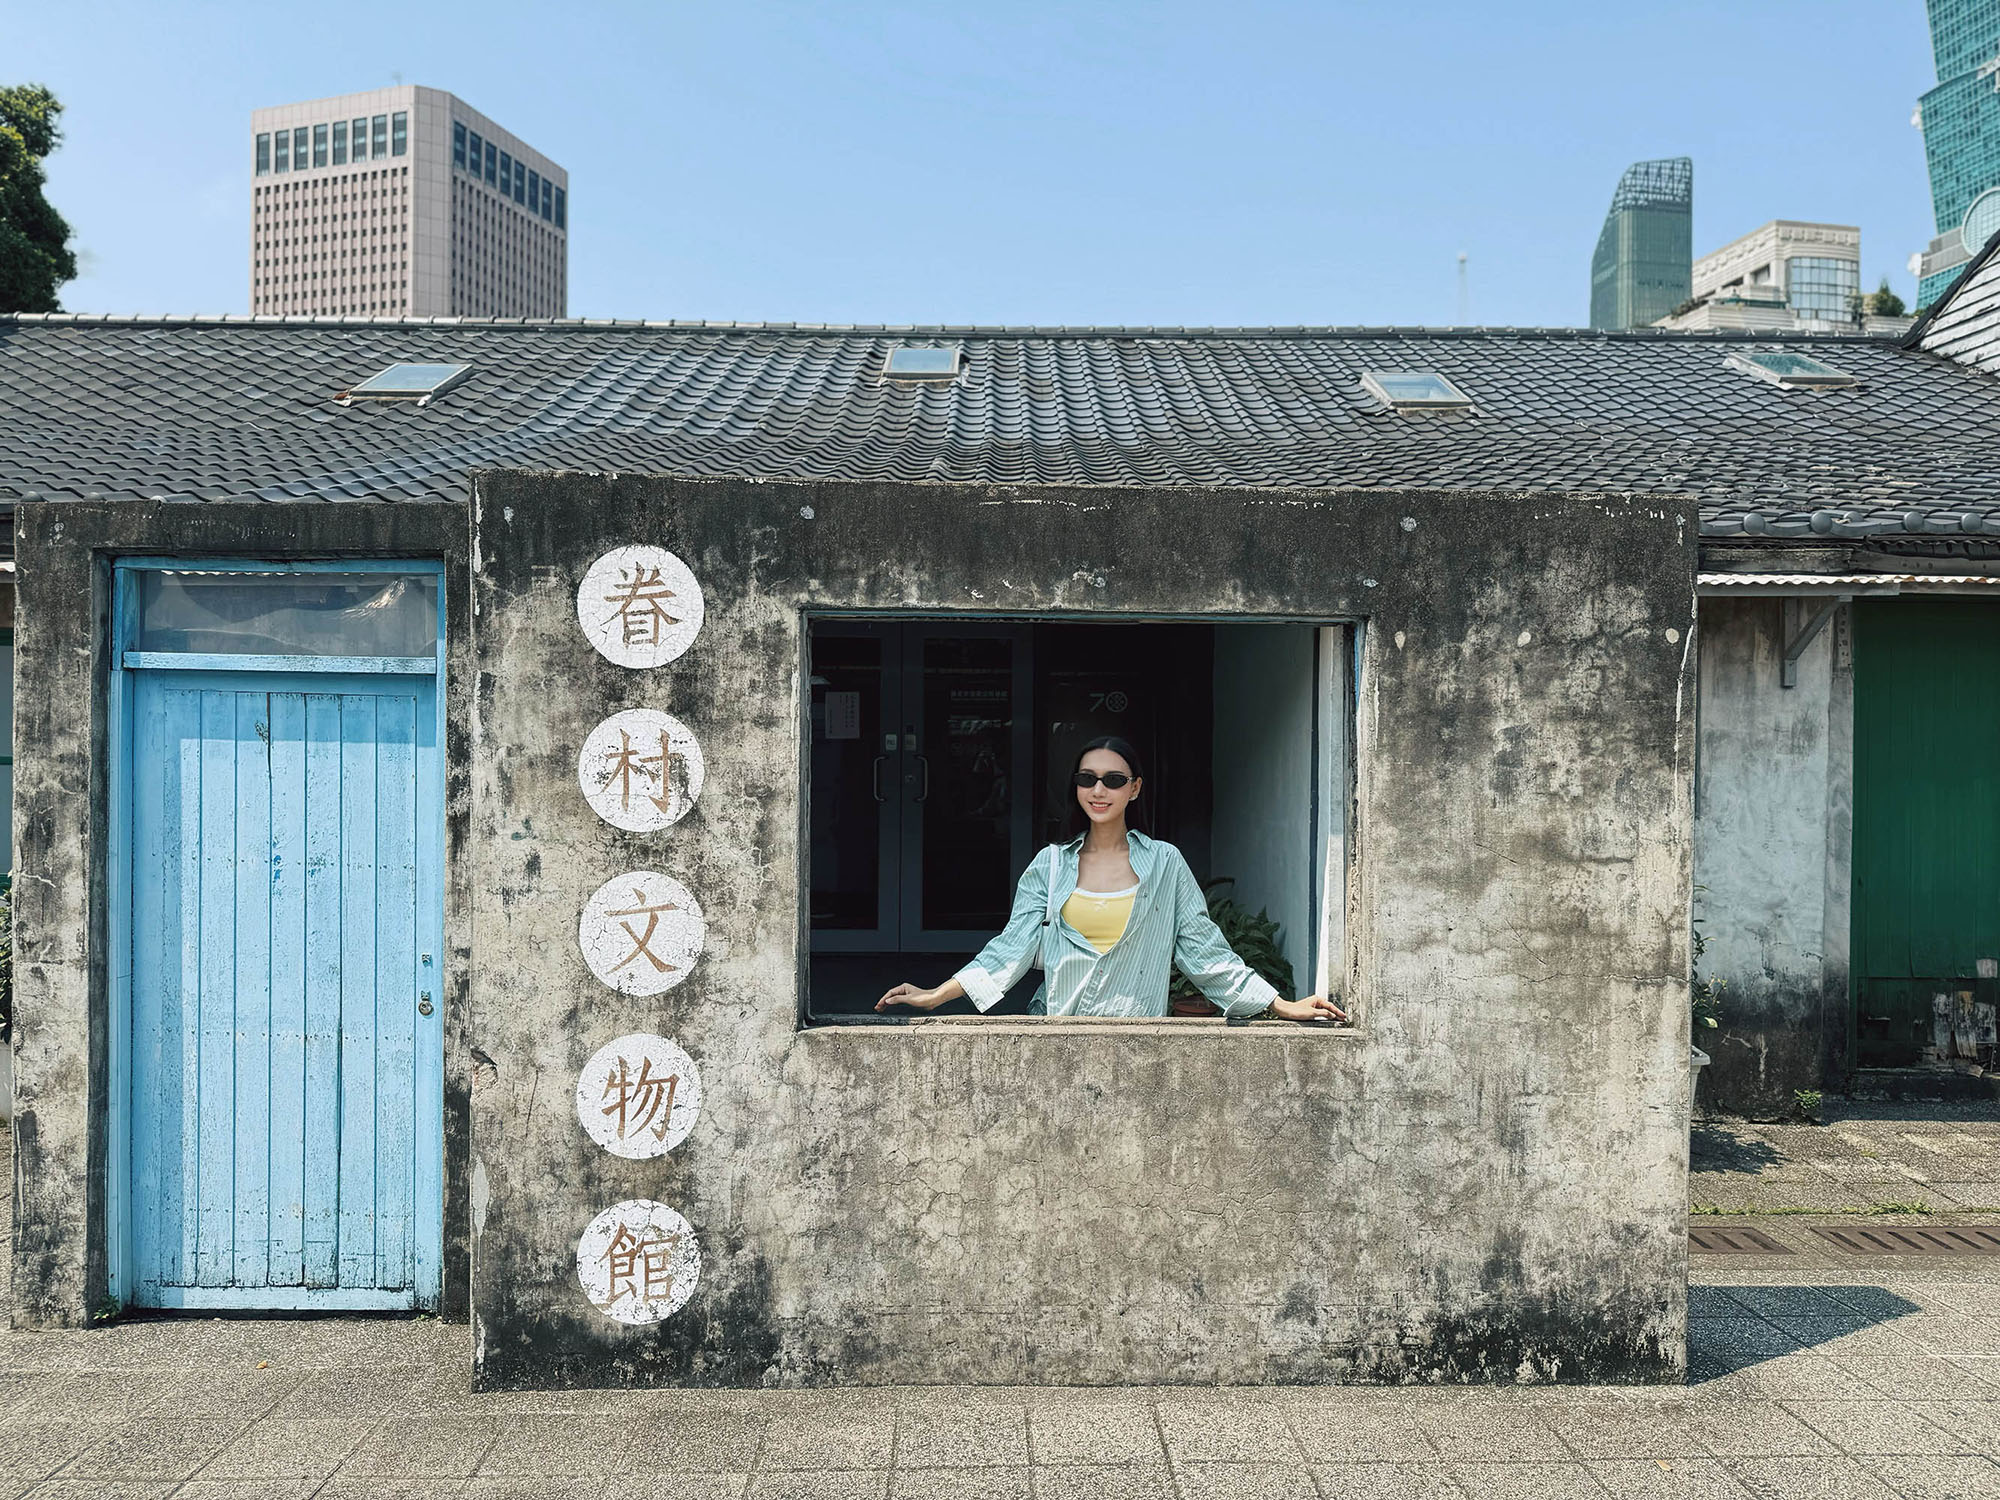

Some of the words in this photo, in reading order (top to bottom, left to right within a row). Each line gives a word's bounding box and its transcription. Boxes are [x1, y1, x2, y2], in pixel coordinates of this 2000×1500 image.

[599, 562, 681, 1304] 眷村文物館
